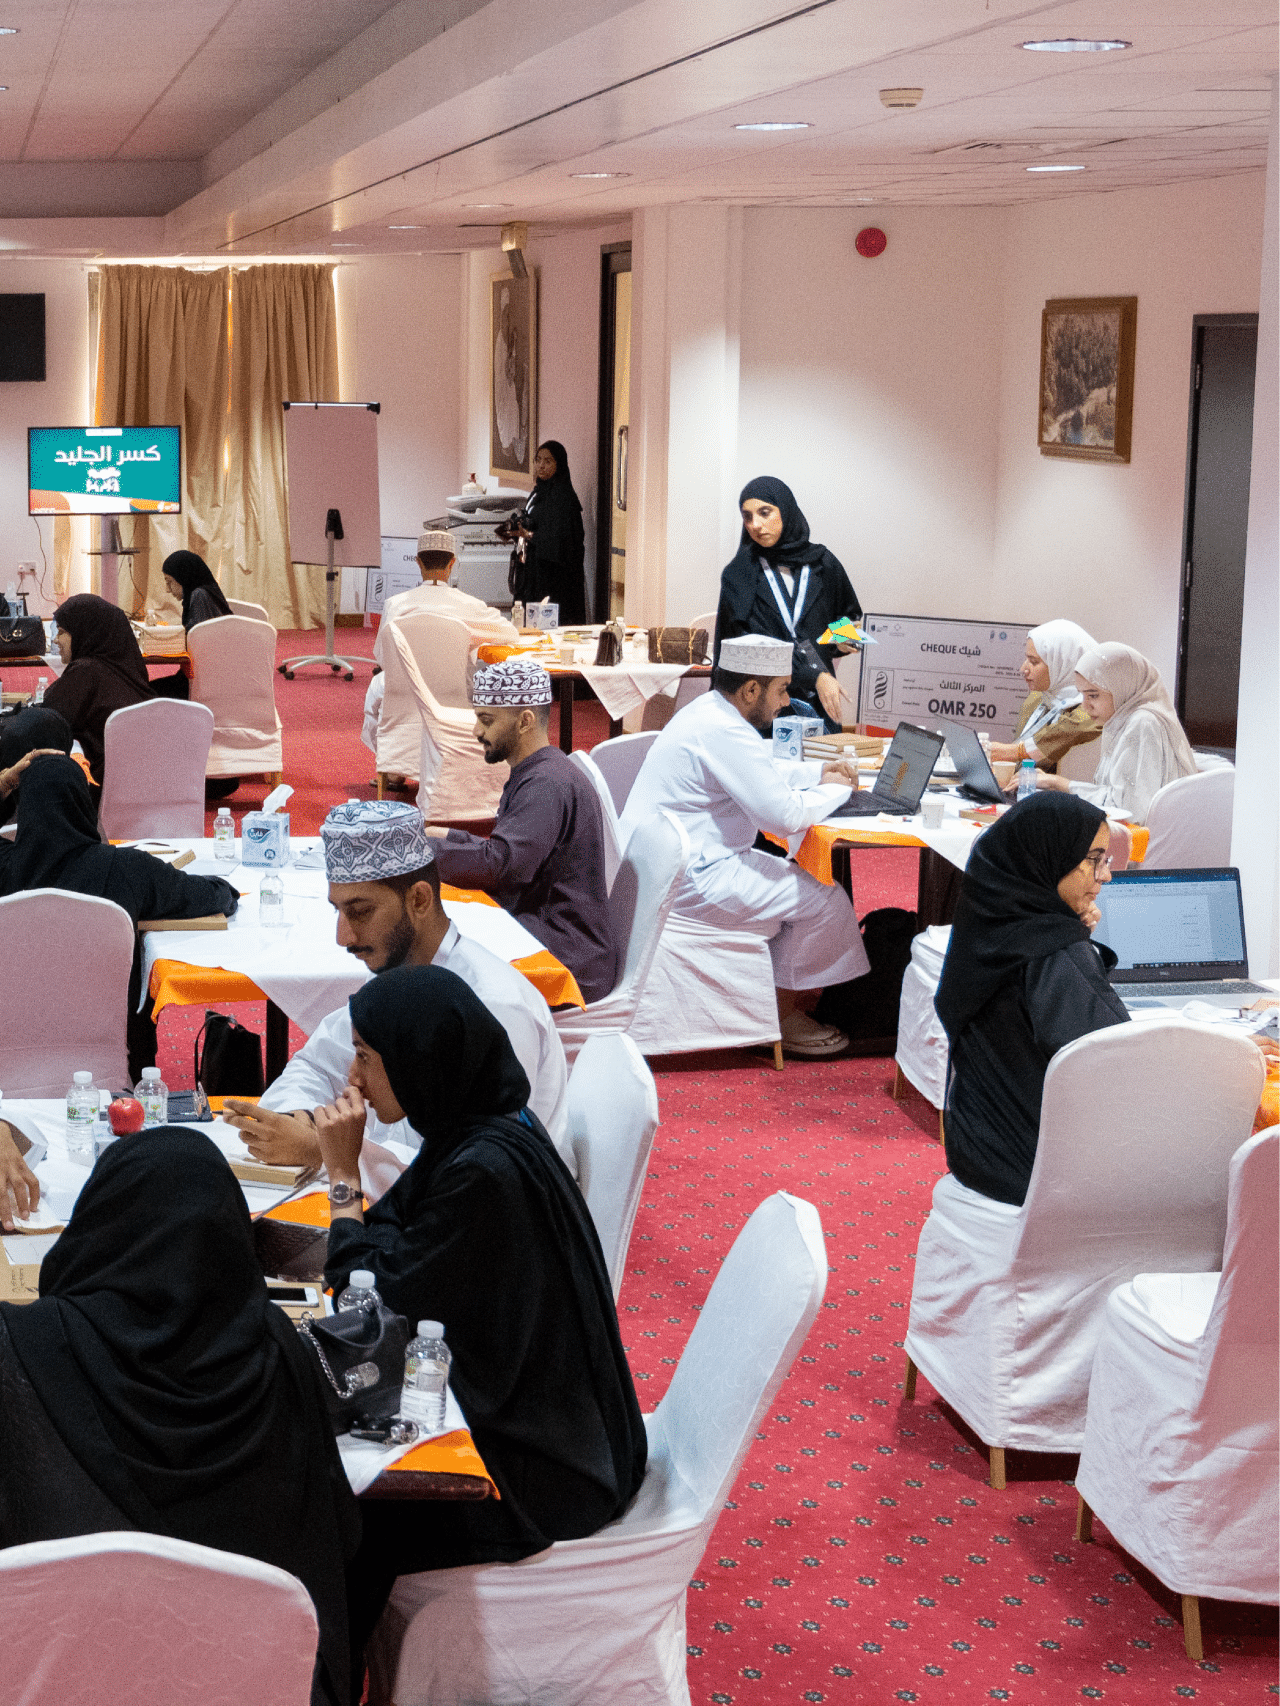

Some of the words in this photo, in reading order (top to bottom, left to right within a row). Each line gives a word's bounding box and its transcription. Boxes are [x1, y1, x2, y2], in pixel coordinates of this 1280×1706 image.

[53, 445, 112, 466] الجليد
[116, 444, 161, 466] كسر
[920, 642, 957, 655] CHEQUE
[959, 645, 982, 658] شيك
[939, 679, 962, 691] الثالث
[963, 681, 986, 694] المركز
[928, 698, 966, 717] OMR
[969, 702, 997, 719] 250
